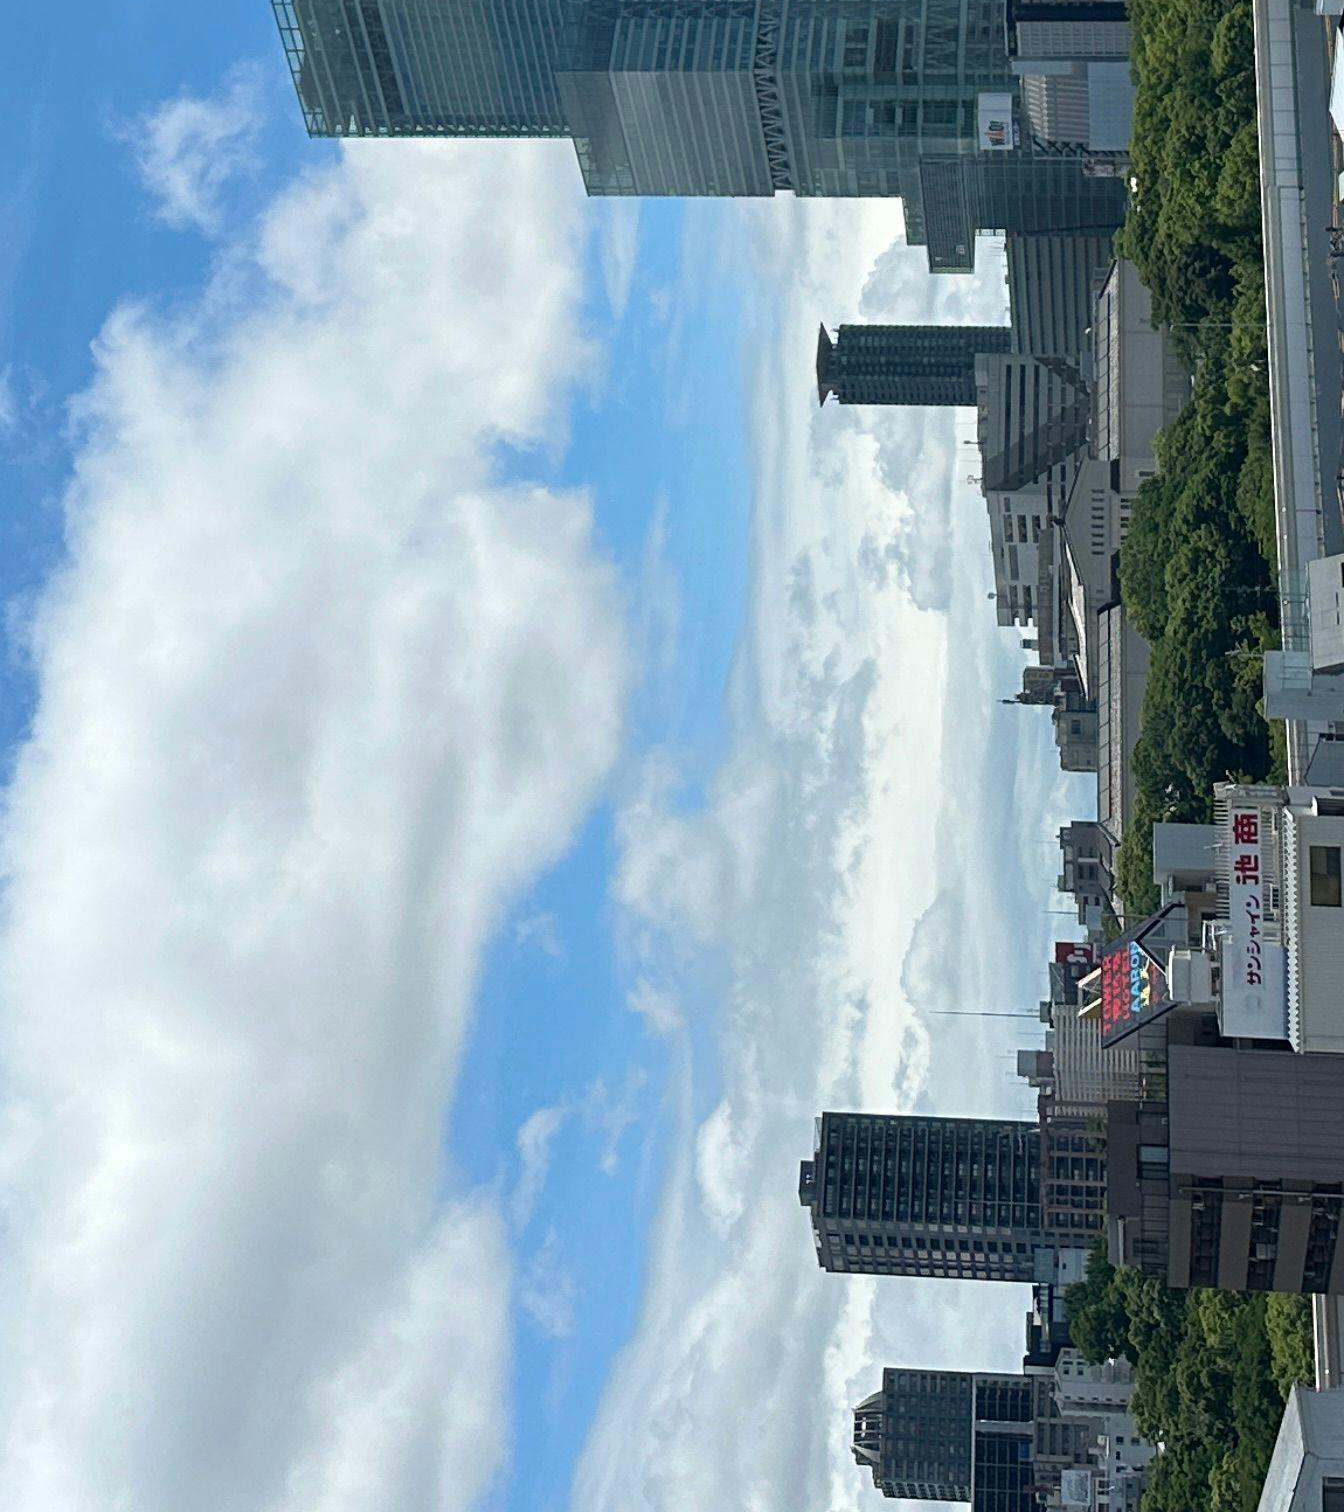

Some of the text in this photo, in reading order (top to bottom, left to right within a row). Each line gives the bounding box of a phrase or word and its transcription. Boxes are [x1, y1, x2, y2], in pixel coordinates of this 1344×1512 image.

[1232, 813, 1262, 985] サンシャイン 池商
